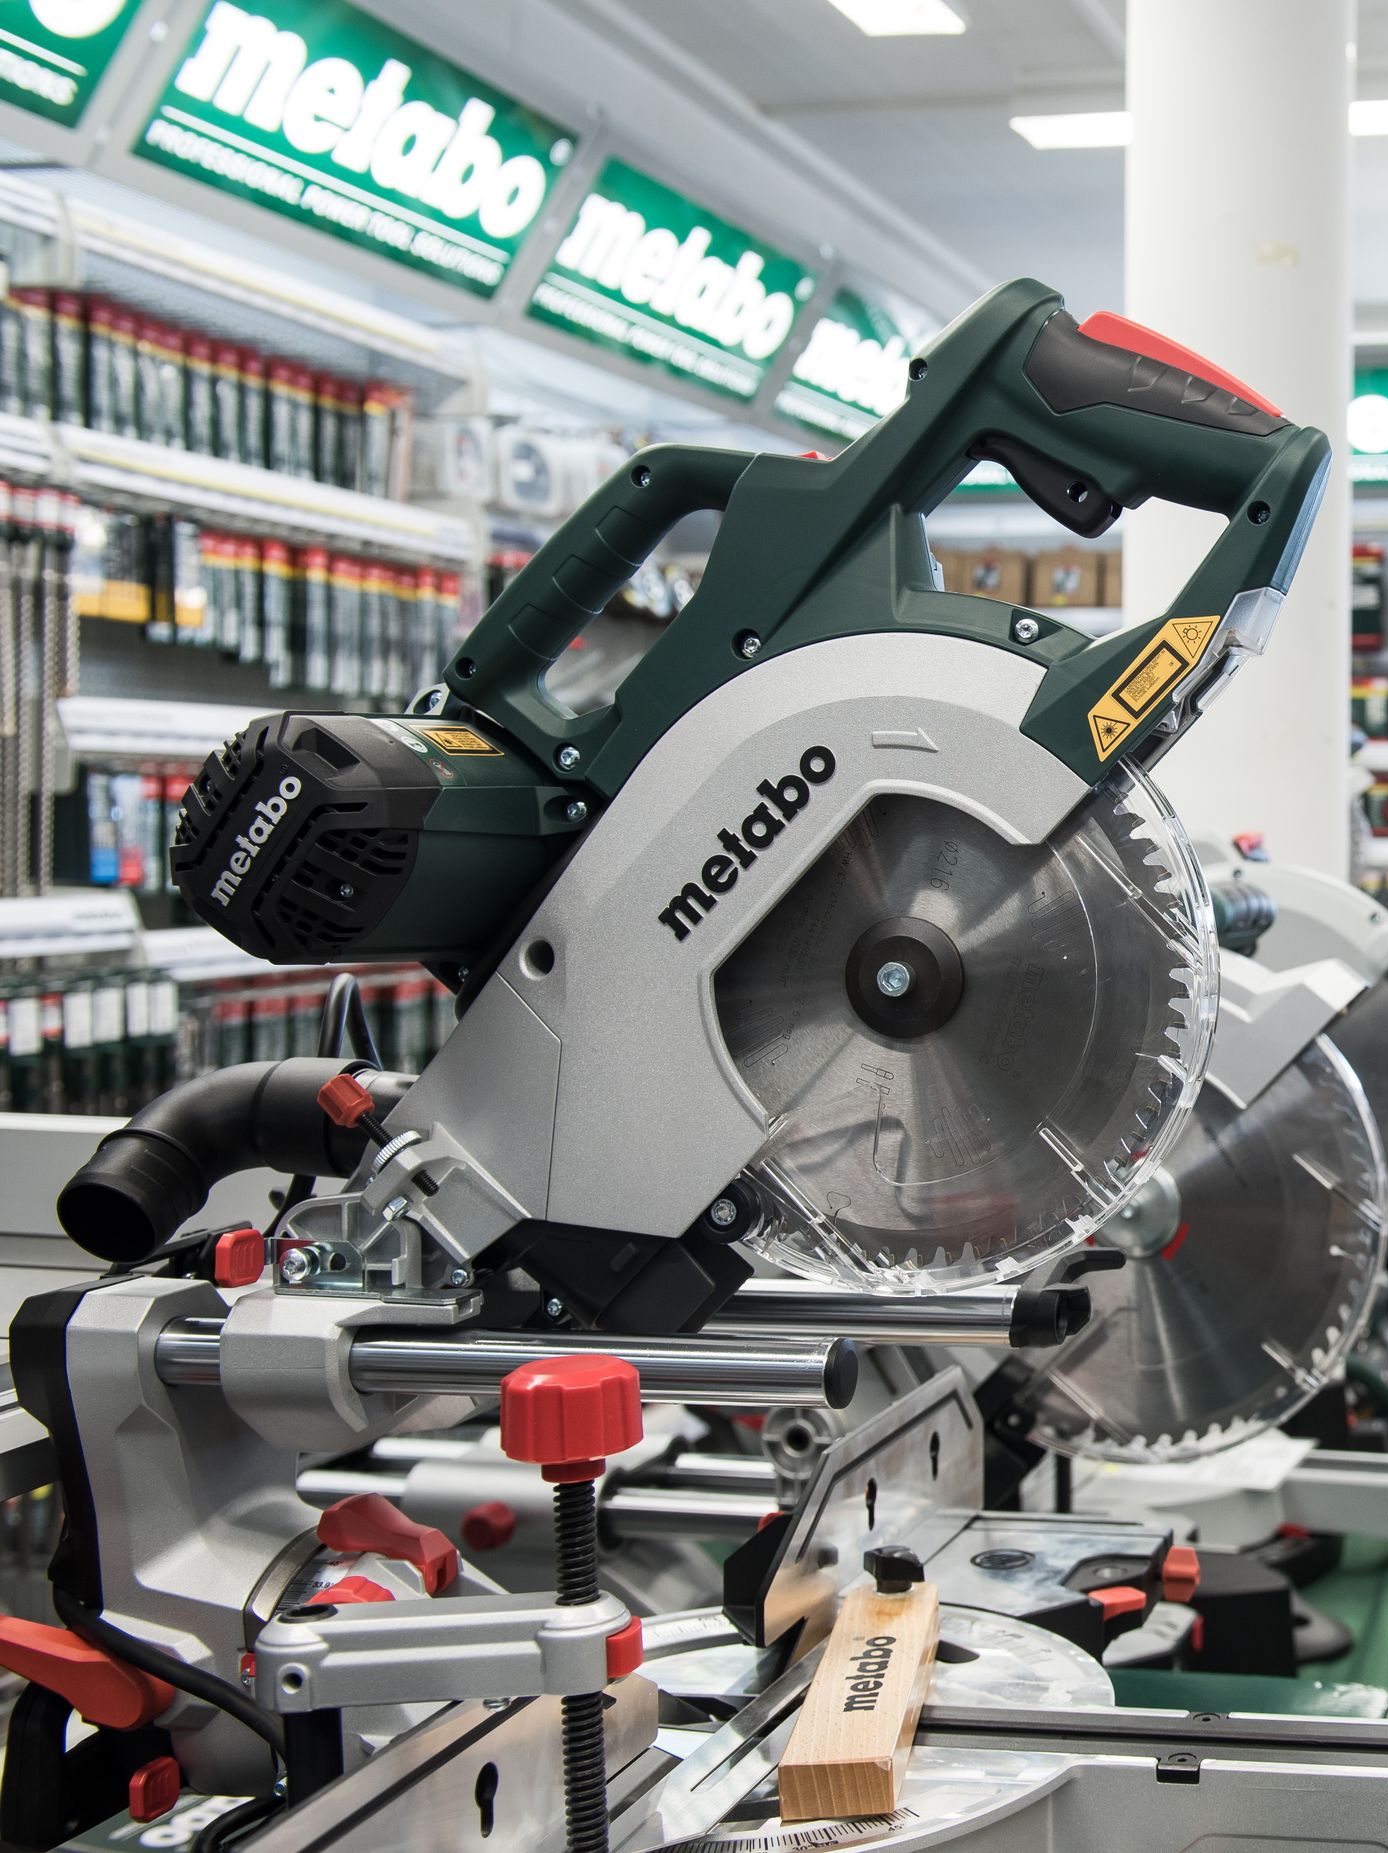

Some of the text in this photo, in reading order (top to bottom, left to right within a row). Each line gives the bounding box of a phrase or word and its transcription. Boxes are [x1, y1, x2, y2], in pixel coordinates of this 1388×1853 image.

[174, 0, 547, 238] metabo
[555, 192, 795, 361] metabo
[792, 317, 910, 417] meta
[210, 775, 302, 907] metabo
[658, 745, 836, 941] metabo
[843, 1635, 897, 1712] metabo
